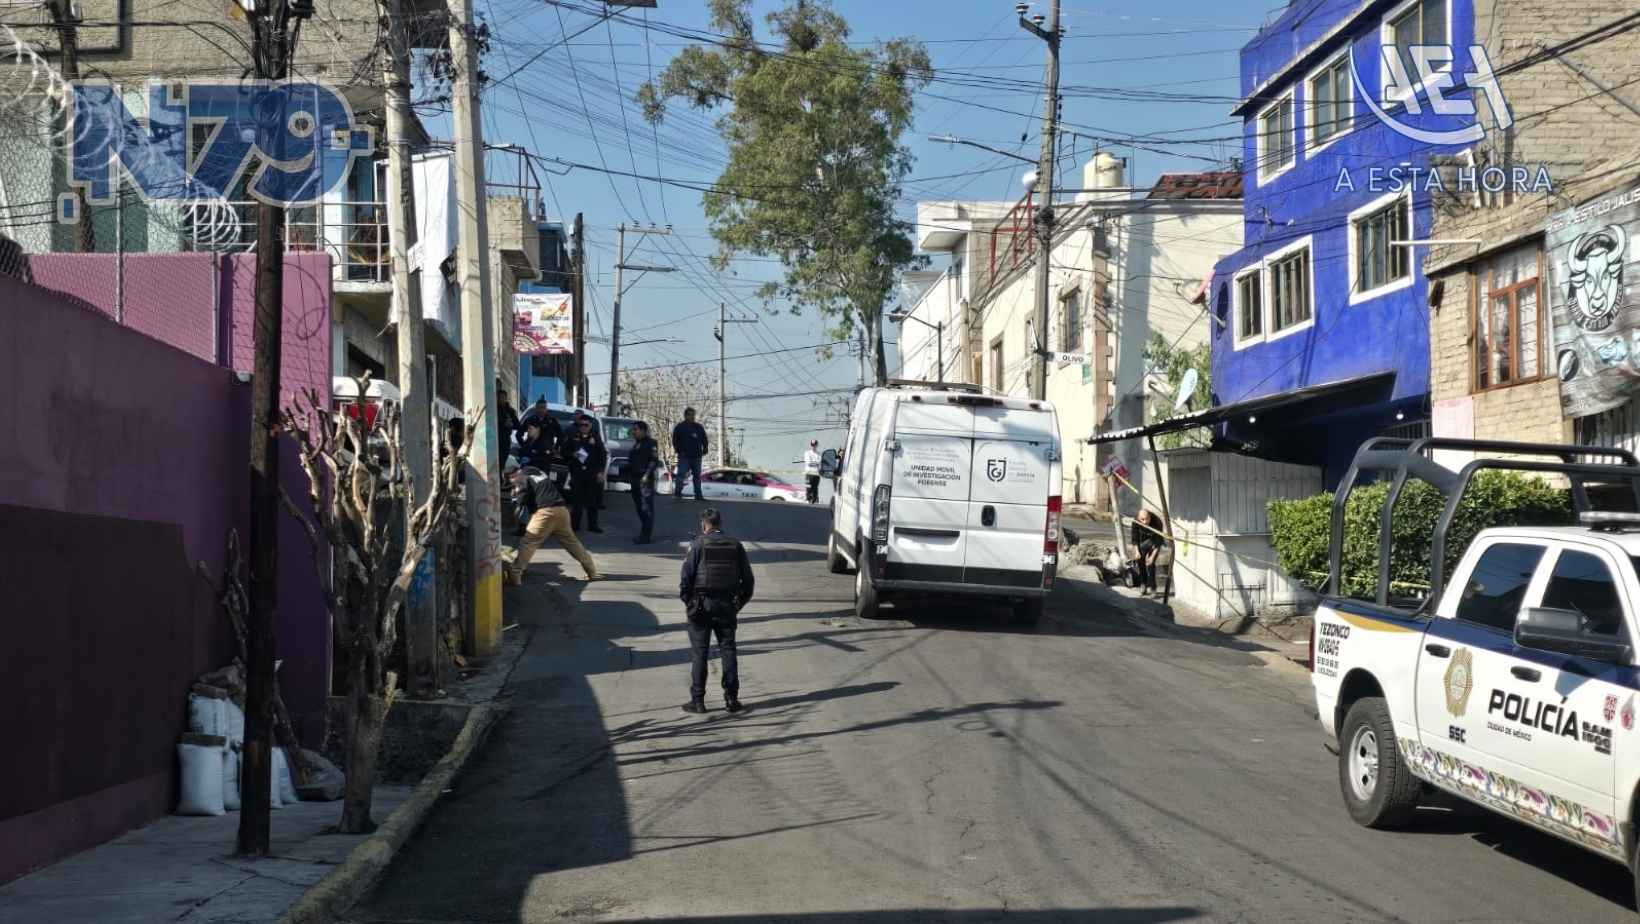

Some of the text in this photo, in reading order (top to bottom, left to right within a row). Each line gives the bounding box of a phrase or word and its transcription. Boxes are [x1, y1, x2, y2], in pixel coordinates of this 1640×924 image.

[1062, 354, 1084, 363] OLIVO
[911, 464, 935, 473] UNIDAD
[917, 479, 947, 487] FORENSE
[1320, 621, 1351, 640] TEZONCO
[1487, 688, 1580, 742] POLICÍA
[1448, 724, 1467, 744] SSC
[1487, 721, 1505, 733] CIUDAD
[1504, 726, 1512, 736] DE
